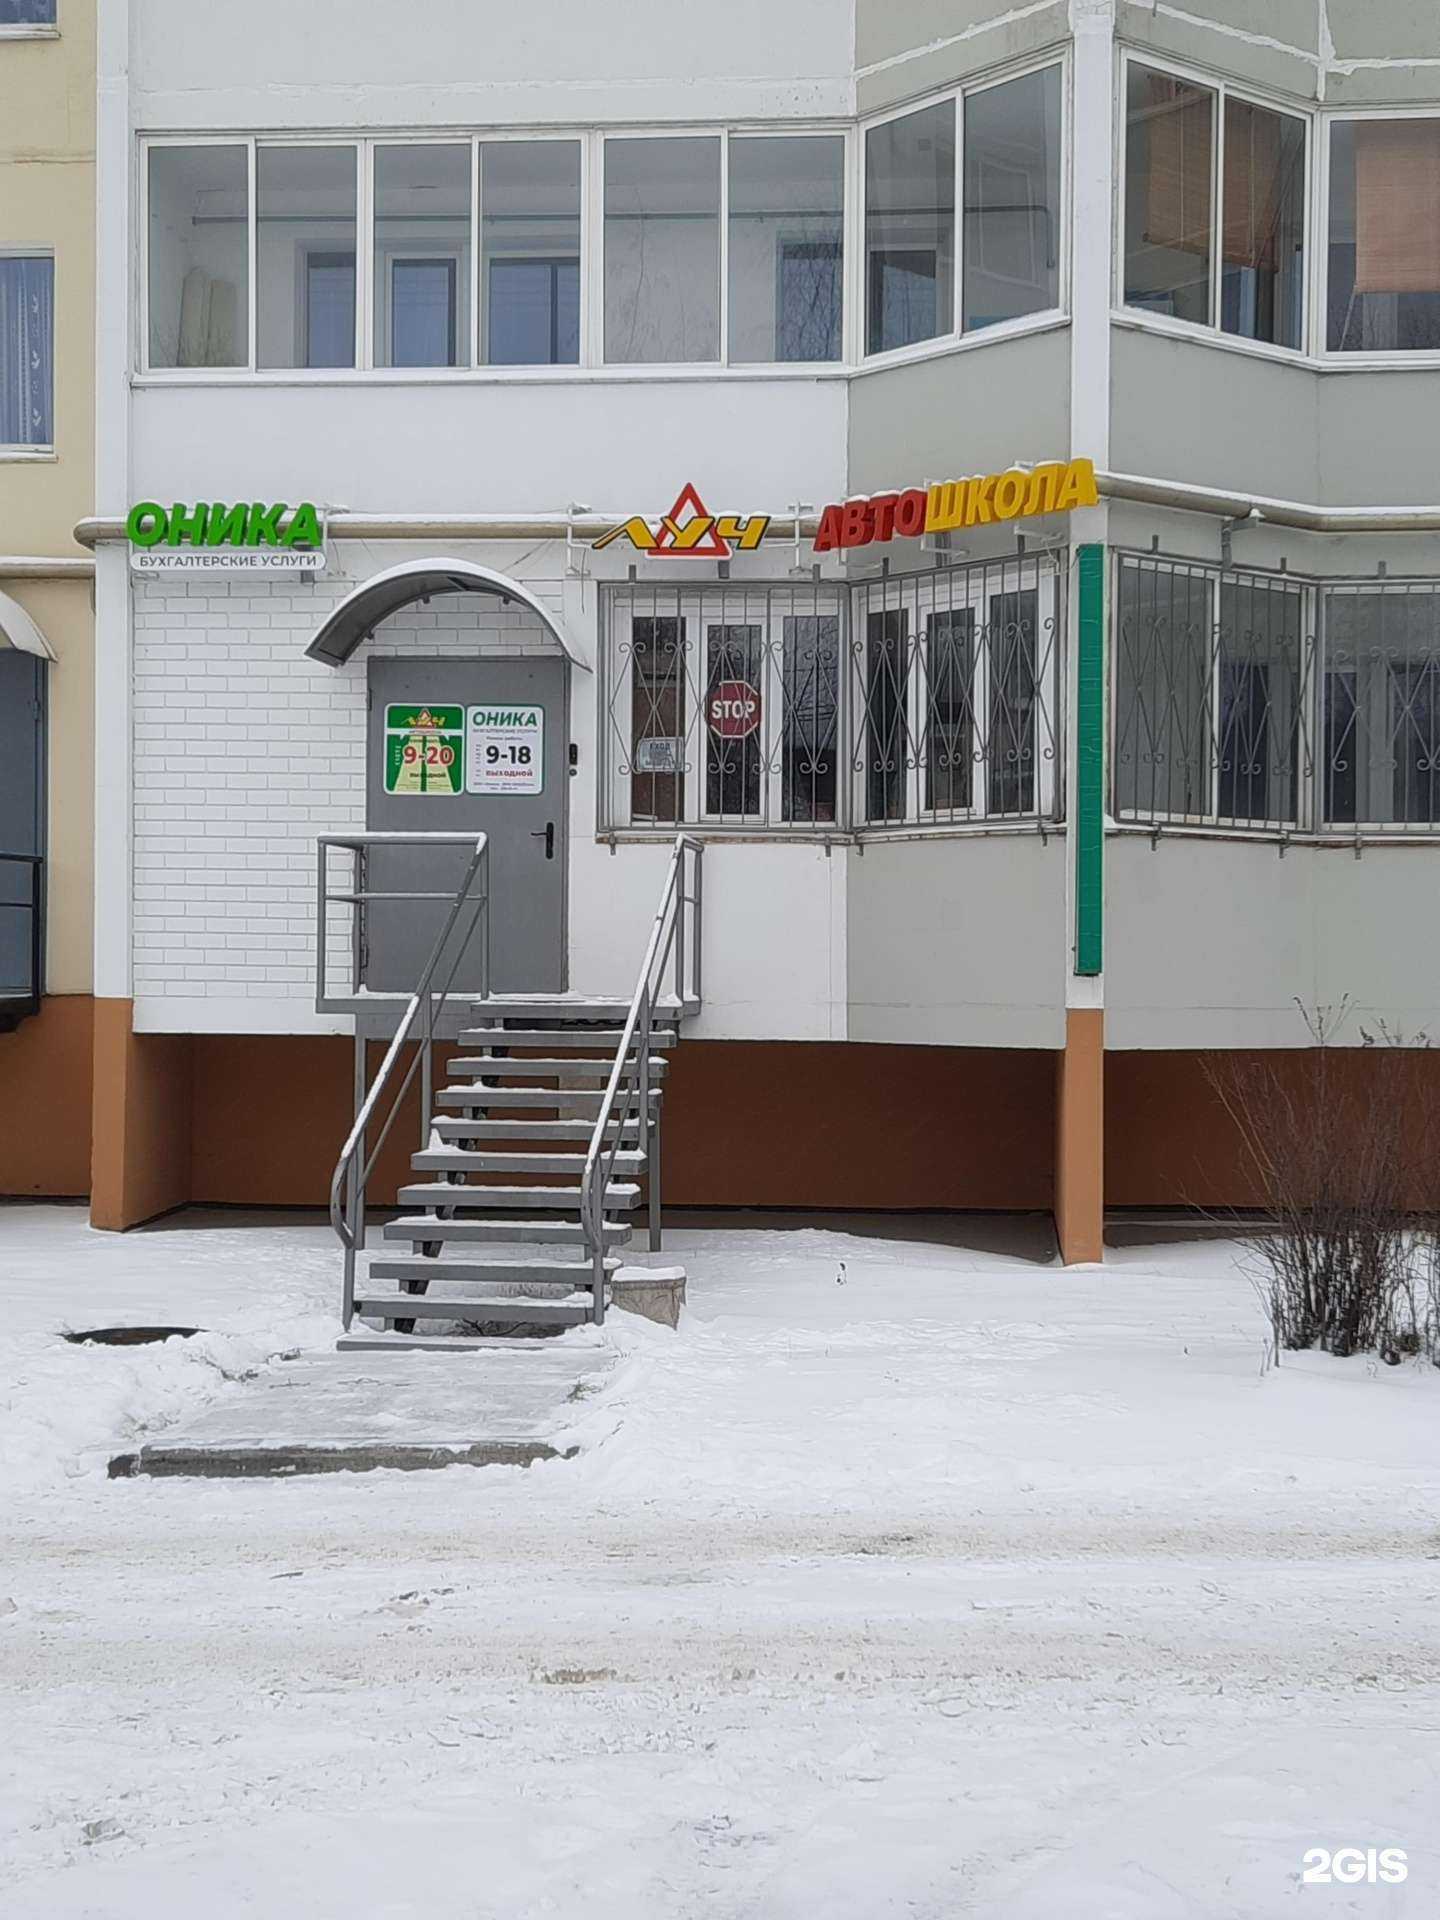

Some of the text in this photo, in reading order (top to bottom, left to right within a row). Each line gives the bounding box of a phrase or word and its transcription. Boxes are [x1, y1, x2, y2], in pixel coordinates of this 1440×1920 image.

[813, 458, 1099, 552] АВТОШКОЛА
[126, 501, 322, 547] ОНИКА
[591, 514, 771, 551] ЛУЧ
[139, 555, 317, 567] БУХГАЛТЕРСКИЕ УСЛУГИ
[472, 711, 538, 726] ОНИКА
[711, 700, 756, 719] STOP
[404, 745, 454, 765] 9-20
[486, 744, 532, 765] 9-18
